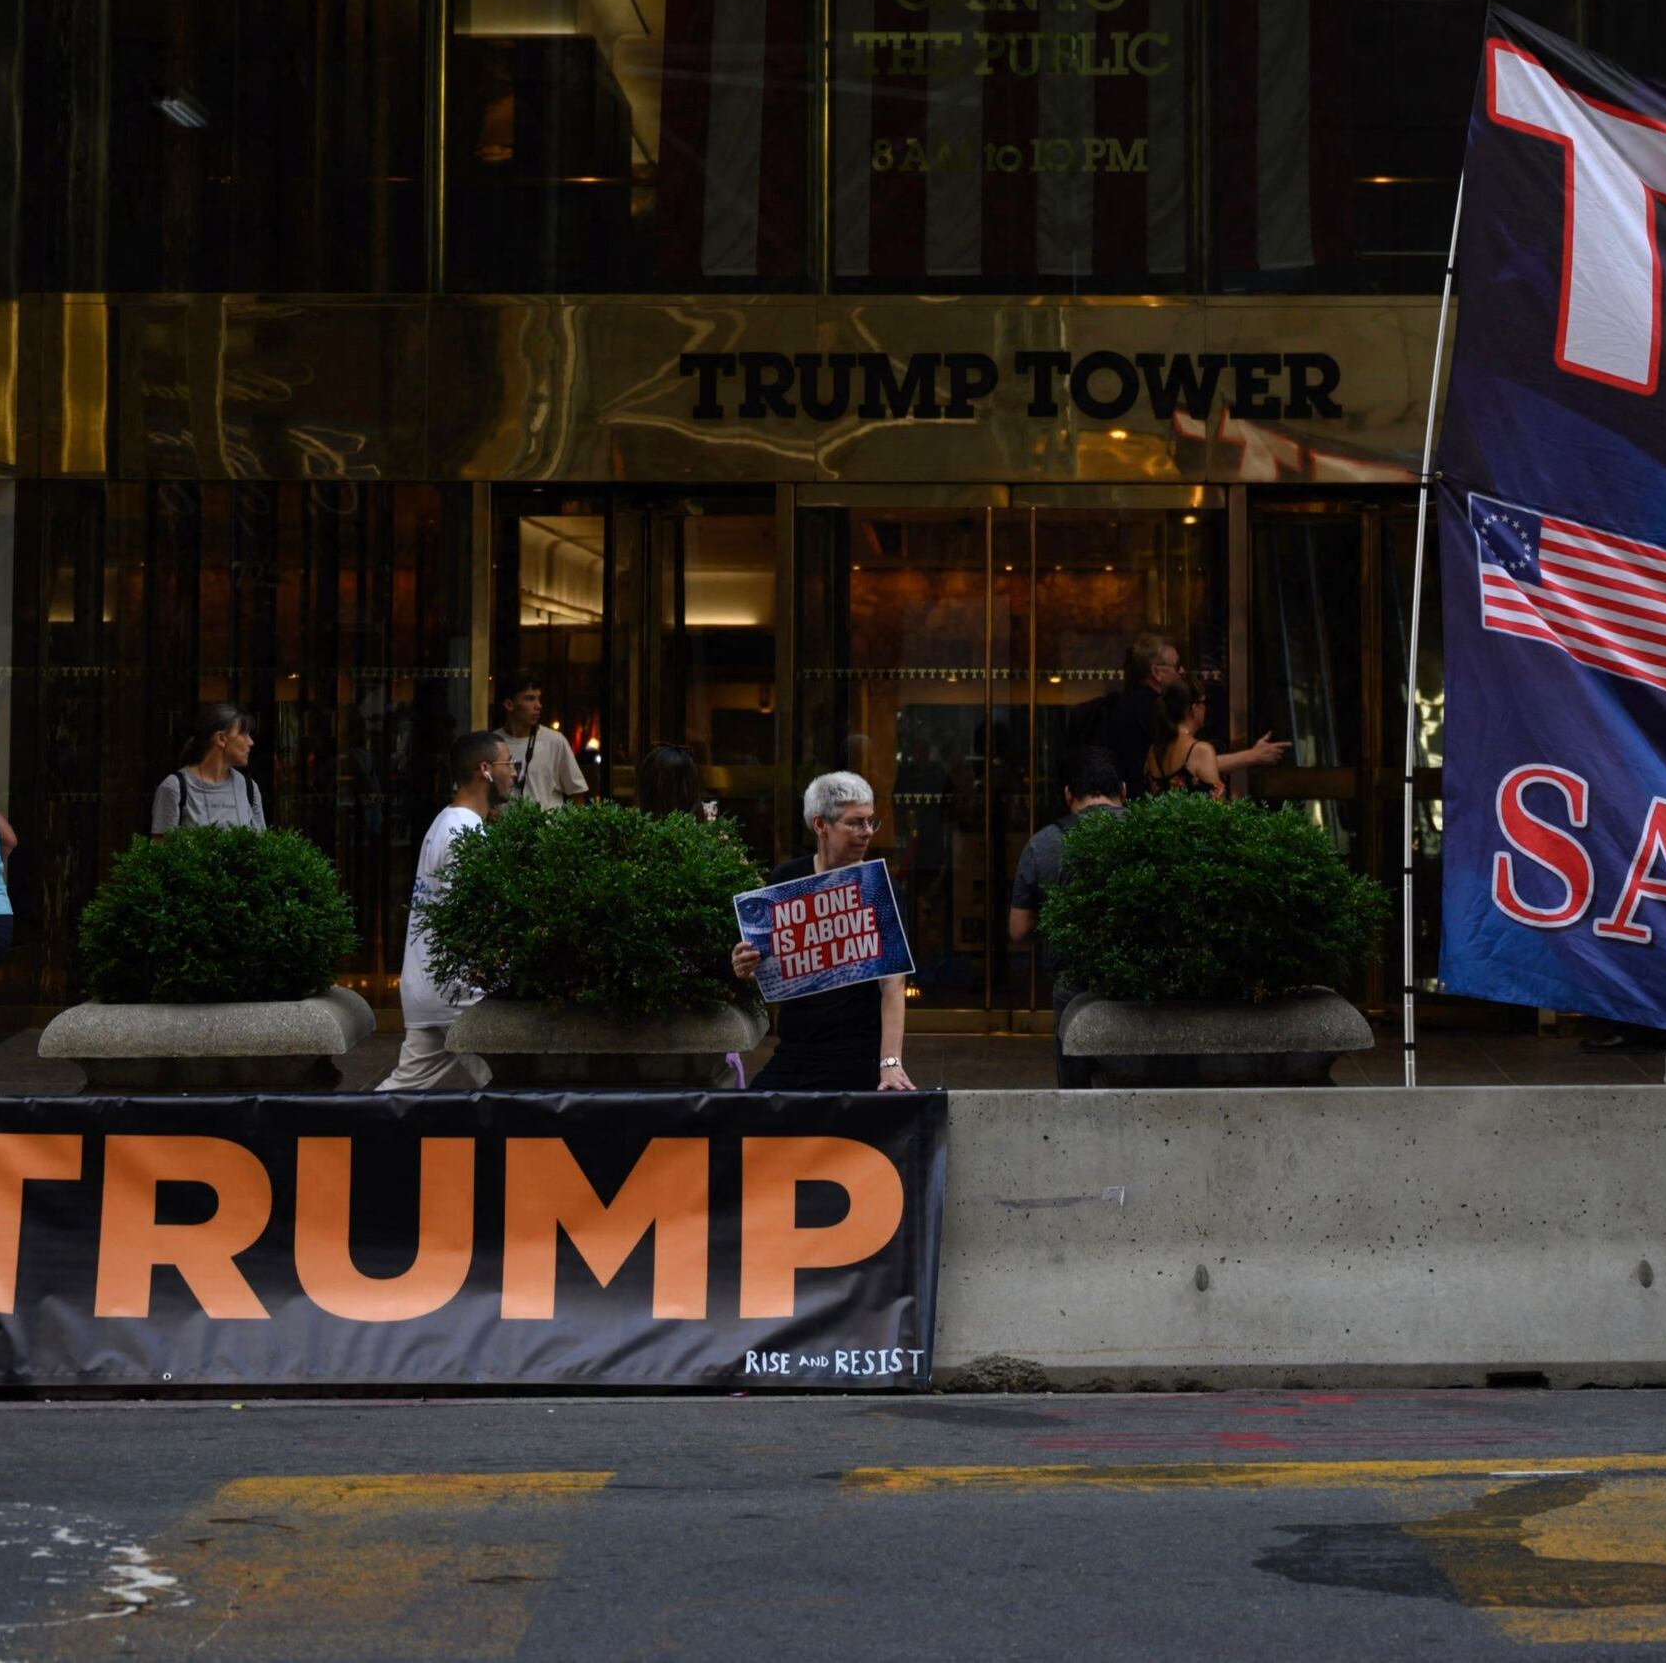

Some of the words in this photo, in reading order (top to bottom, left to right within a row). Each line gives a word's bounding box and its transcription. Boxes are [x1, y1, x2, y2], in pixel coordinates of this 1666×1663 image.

[852, 31, 963, 77] THE
[973, 31, 1171, 77] PUBLIC
[871, 138, 893, 173] 8
[899, 138, 975, 173] AM
[1082, 138, 1150, 173] PM
[680, 351, 1000, 421] TRUMP
[1015, 350, 1343, 421] TOWER
[774, 899, 807, 929] NO
[814, 886, 860, 913] ONE
[772, 930, 796, 956] IS
[803, 907, 876, 948] ABOVE
[783, 948, 824, 978] THE
[831, 932, 879, 966] LAW
[745, 1350, 791, 1375] RISE
[799, 1355, 829, 1368] AND
[835, 1348, 924, 1375] RESIST
